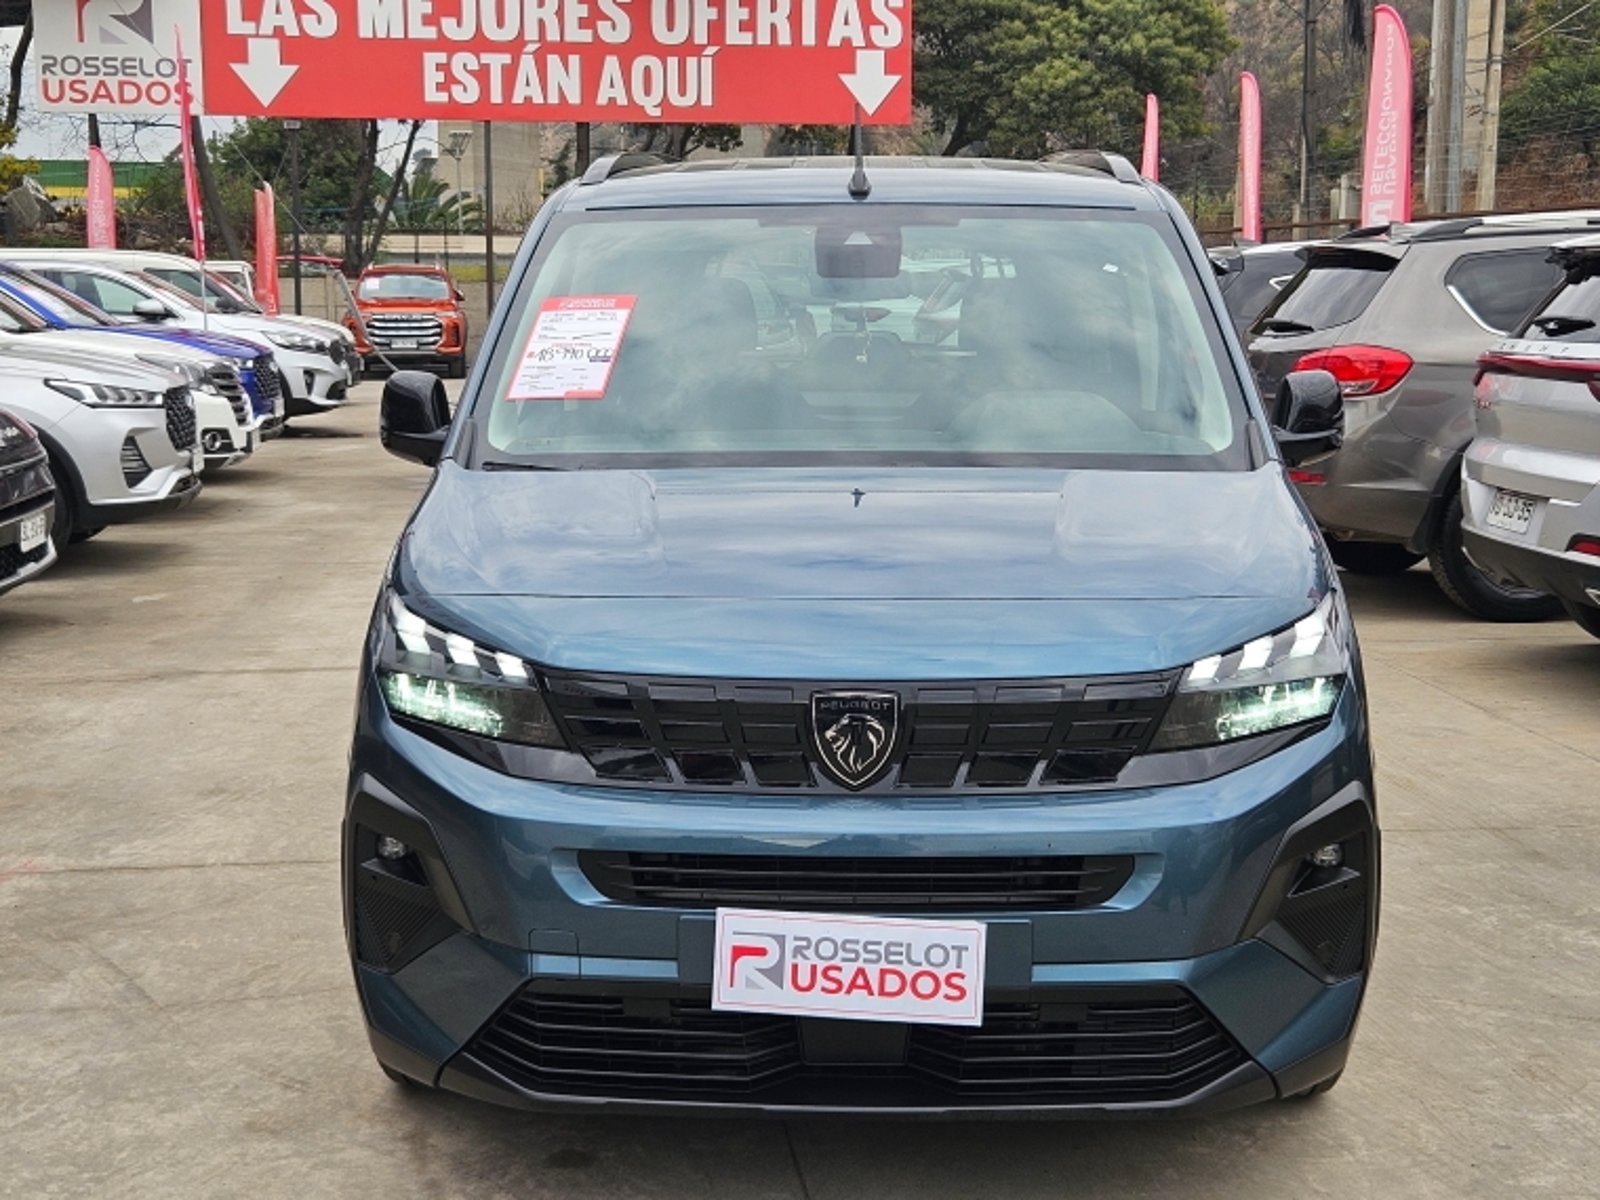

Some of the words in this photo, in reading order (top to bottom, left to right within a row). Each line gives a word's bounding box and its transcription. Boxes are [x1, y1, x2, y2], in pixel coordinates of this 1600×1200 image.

[225, 0, 339, 37] LAS
[357, 0, 631, 43] MEJORES
[651, 0, 904, 48] OFERTAS
[41, 55, 192, 78] ROSSELOT
[422, 43, 582, 105] ESTÁN
[596, 46, 721, 117] AQUÍ
[41, 79, 194, 105] USADOS
[819, 700, 891, 711] PEUGEOT
[791, 936, 969, 969] ROSSELOT
[790, 963, 968, 1002] USADOS
